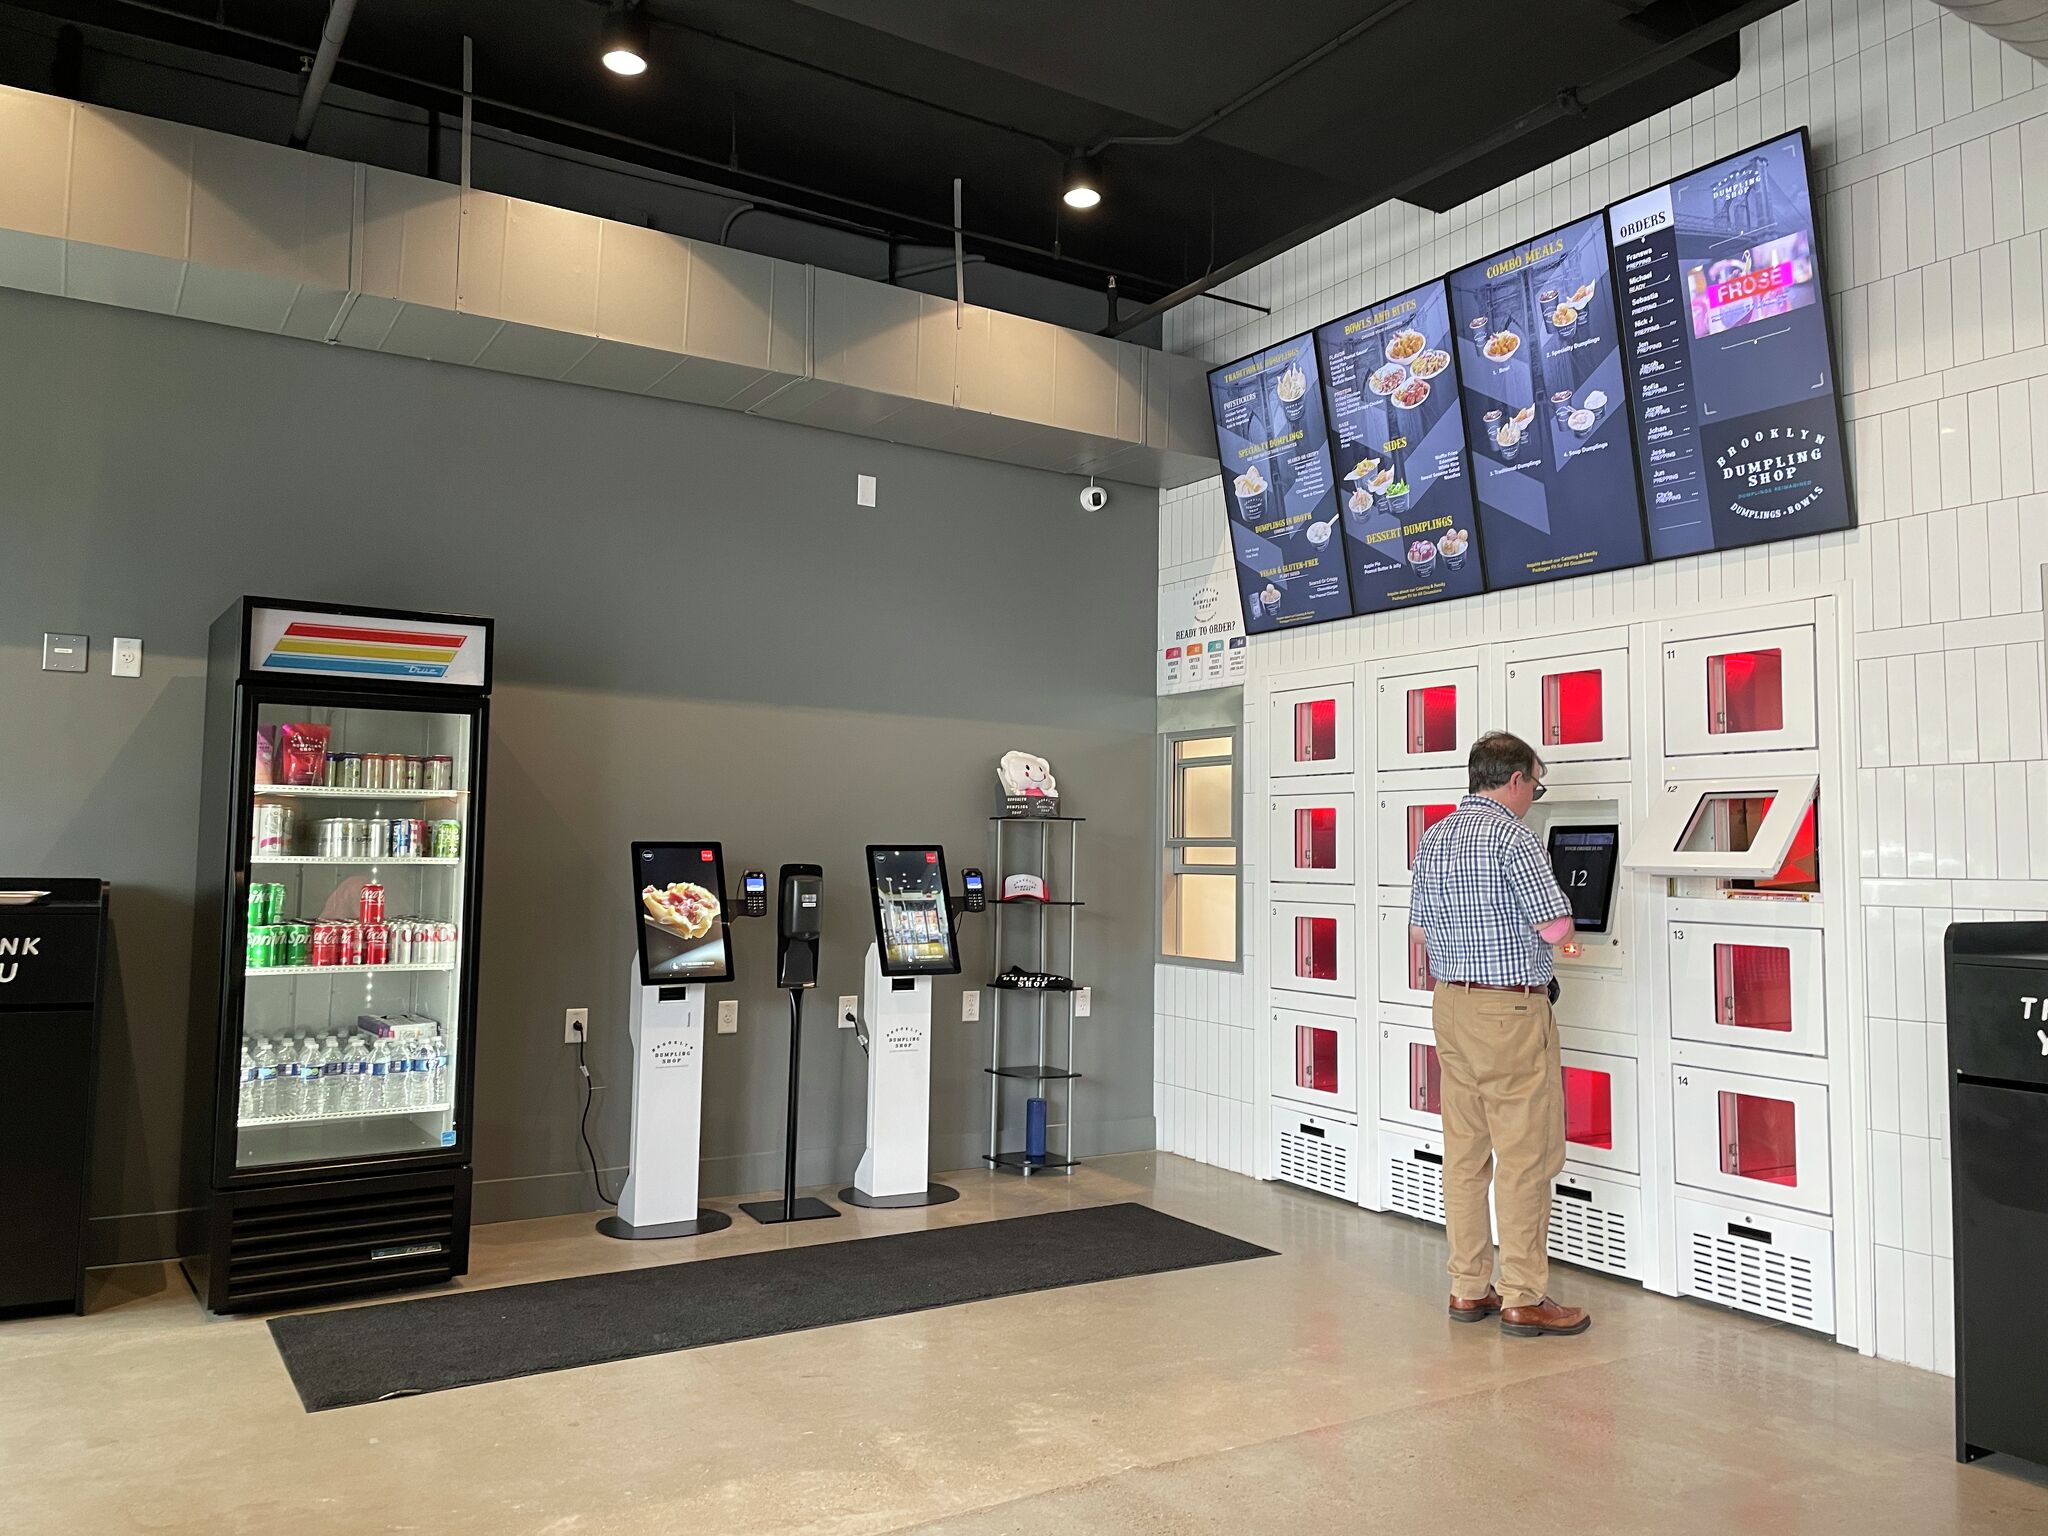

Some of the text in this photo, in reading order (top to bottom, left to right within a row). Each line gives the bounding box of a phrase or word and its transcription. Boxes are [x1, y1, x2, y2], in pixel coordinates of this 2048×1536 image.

[1713, 175, 1761, 199] DUMPLING
[1620, 211, 1666, 238] ORDERS
[1486, 239, 1564, 279] COMBO MEALS
[1626, 257, 1651, 272] PREPPING
[1629, 271, 1652, 285] Michael
[1629, 283, 1646, 294] READY
[1632, 302, 1657, 316] PREPPING
[1344, 317, 1372, 335] BOWLS
[1374, 309, 1390, 324] AND
[1392, 299, 1416, 317] BITES
[1635, 318, 1648, 328] Nick
[1635, 324, 1660, 337] PREPPING
[1552, 344, 1573, 357] Specialty
[1574, 336, 1600, 350] Dumplings
[1637, 342, 1662, 355] PREPPING
[1224, 362, 1263, 383] TRADITIONAL
[1642, 386, 1668, 398] PREPPING
[1645, 408, 1670, 419] PREPPING
[1648, 430, 1673, 441] PREPPING
[1239, 441, 1269, 459] SPECIALTY
[1269, 430, 1303, 449] DUMPLINGS
[1383, 437, 1407, 453] SIDES
[1569, 448, 1581, 456] Soup
[1582, 442, 1608, 454] Dumplings
[1716, 427, 1826, 468] BROOKLYN
[1651, 451, 1676, 462] PREPPING
[1517, 458, 1542, 470] Dumplings
[1722, 448, 1822, 480] DUMPLING
[1653, 474, 1679, 484] PREPPING
[1748, 466, 1797, 487] SHOP
[1656, 494, 1681, 504] PREPPING
[1730, 486, 1824, 519] DUMPLINGS BOWLS
[1255, 519, 1286, 534] DUMPLINGS
[1366, 515, 1453, 544] DESSERT DUMPLINGS
[1282, 558, 1320, 573] GLUTEN-FREE
[1176, 620, 1236, 640] READY TO ORDER?
[1667, 650, 1675, 659] 11
[1510, 670, 1515, 679] 9
[1380, 685, 1384, 693] 5
[1667, 785, 1677, 793] 12
[1381, 800, 1385, 808] 6
[1570, 870, 1588, 886] 12
[1673, 931, 1684, 940] 13
[1018, 980, 1048, 988] SHOP
[1678, 1077, 1688, 1086] 14
